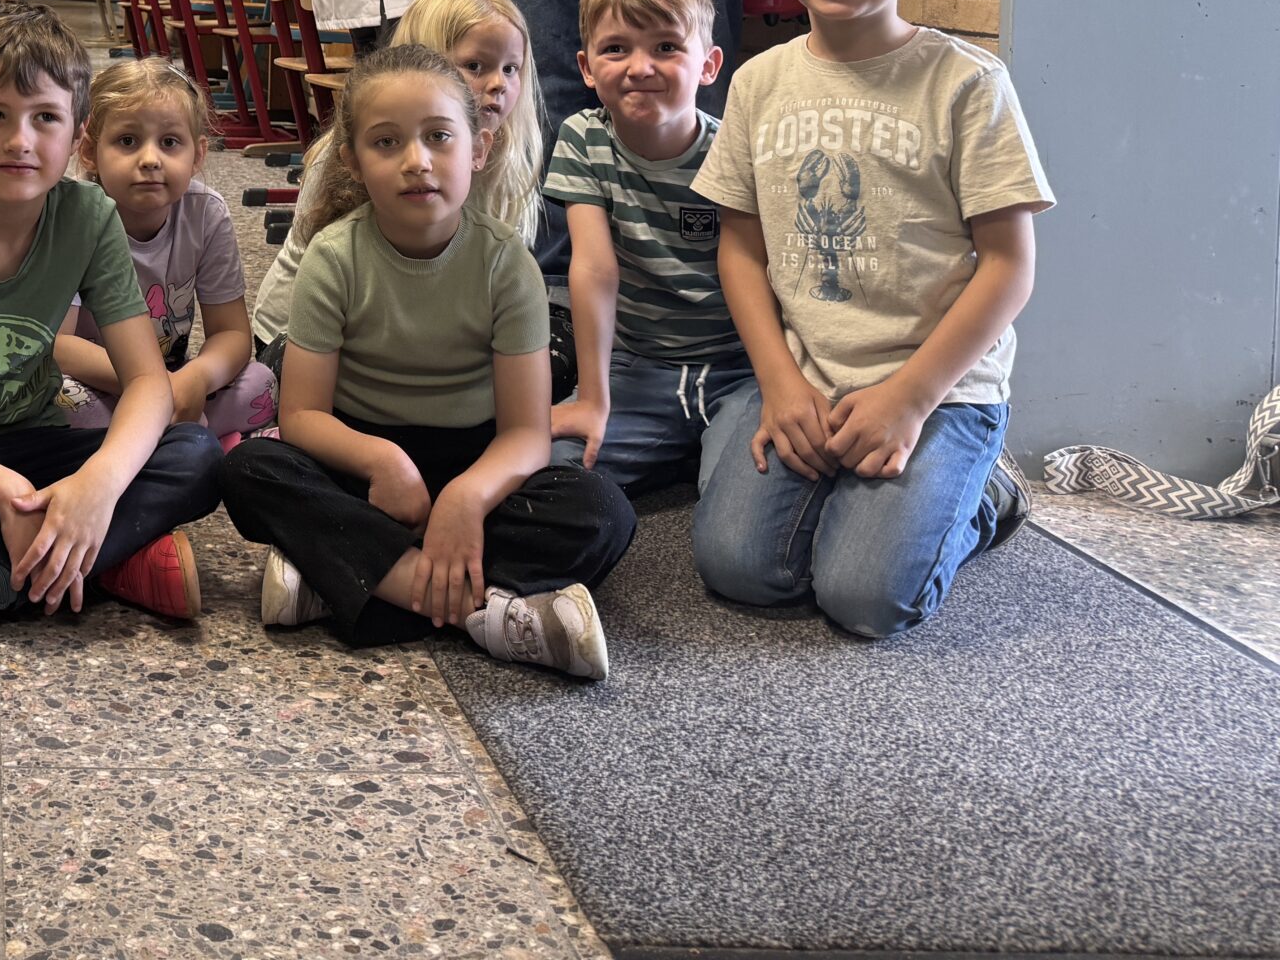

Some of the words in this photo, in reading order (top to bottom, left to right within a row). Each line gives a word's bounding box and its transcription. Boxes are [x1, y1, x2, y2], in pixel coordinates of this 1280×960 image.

[755, 108, 921, 169] LOBSTER
[785, 232, 815, 248] THE
[821, 234, 876, 251] OCEAN
[781, 252, 799, 267] IS
[808, 254, 878, 272] CALING
